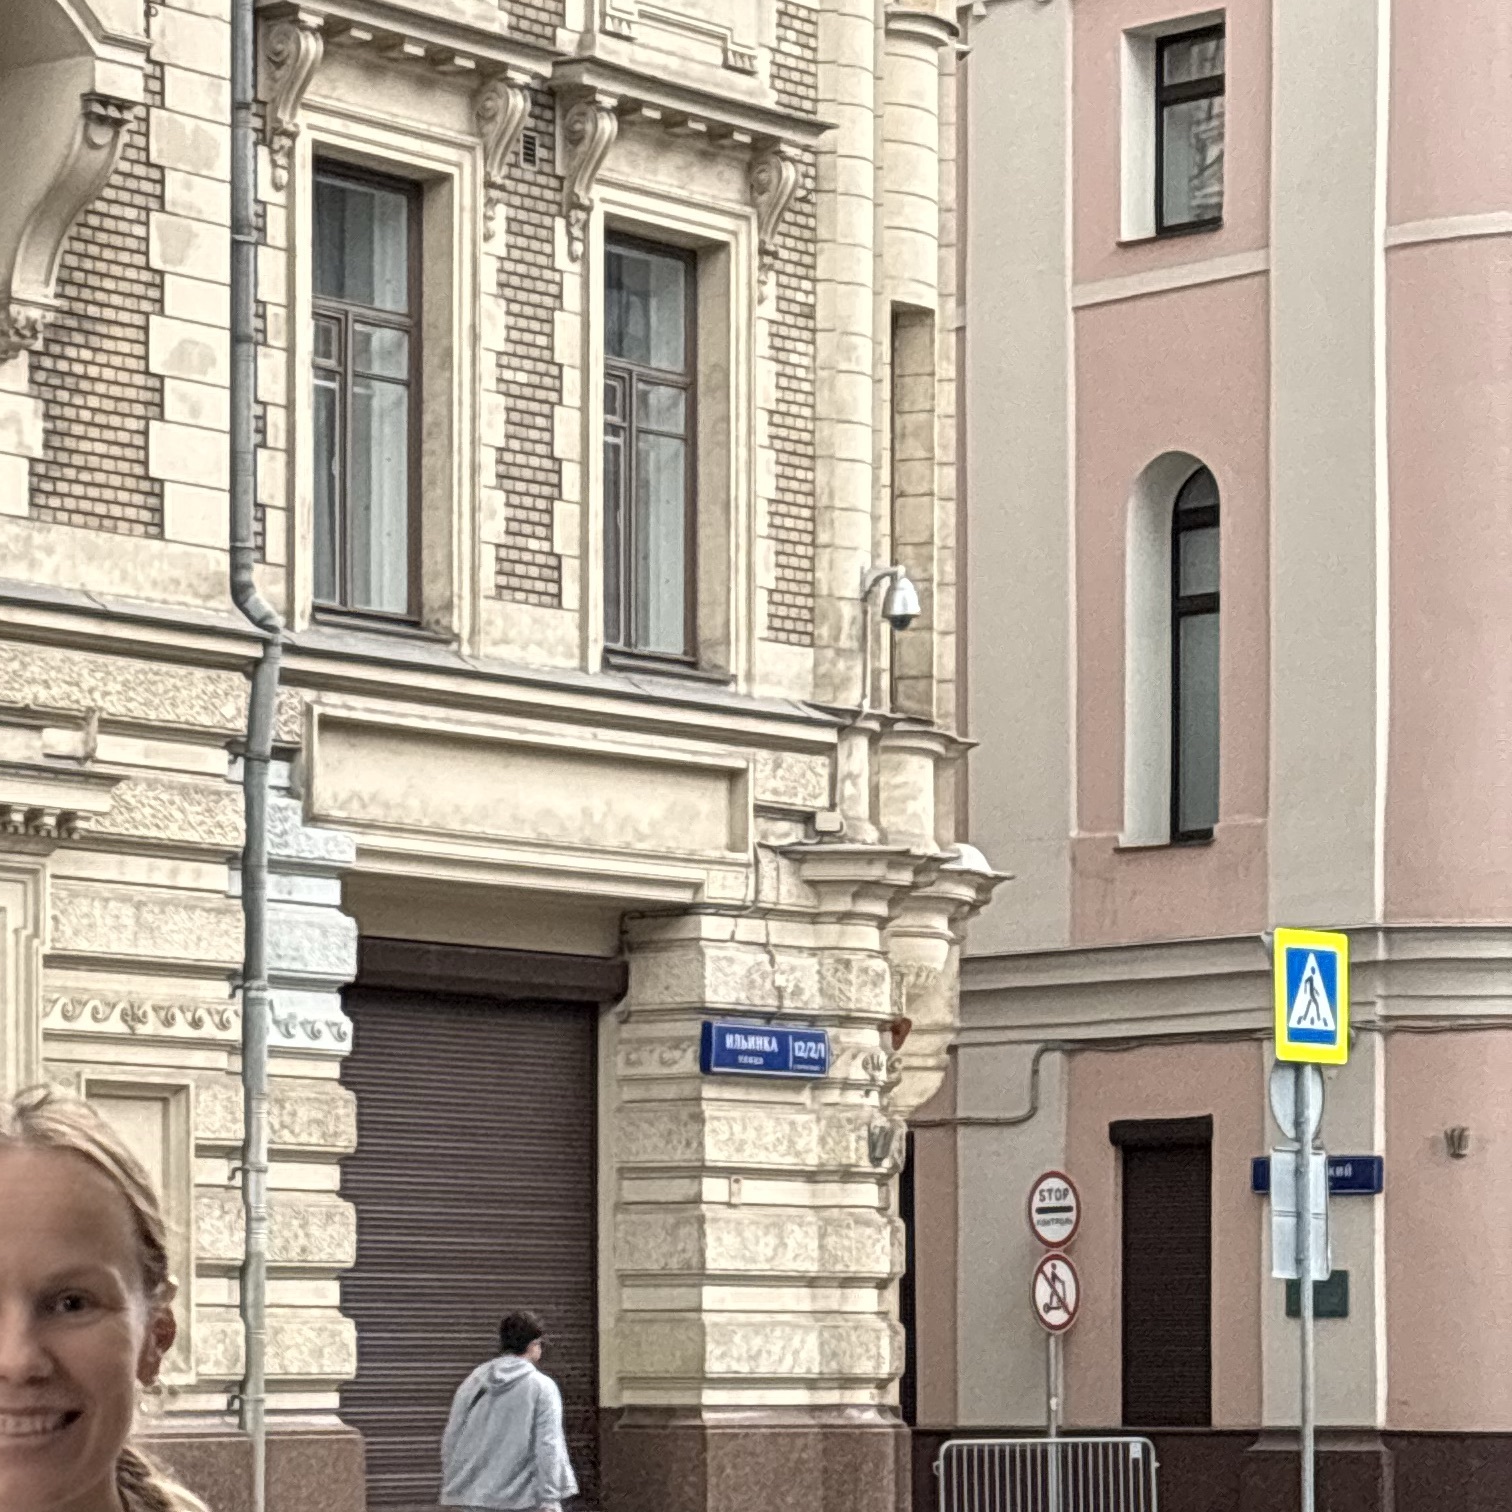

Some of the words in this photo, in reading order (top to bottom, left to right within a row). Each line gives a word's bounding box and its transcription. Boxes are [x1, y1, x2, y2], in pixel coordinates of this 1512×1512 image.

[726, 1033, 778, 1052] ИЛЬИНКА
[794, 1041, 825, 1059] 12/2/1
[1039, 1188, 1069, 1202] STOP
